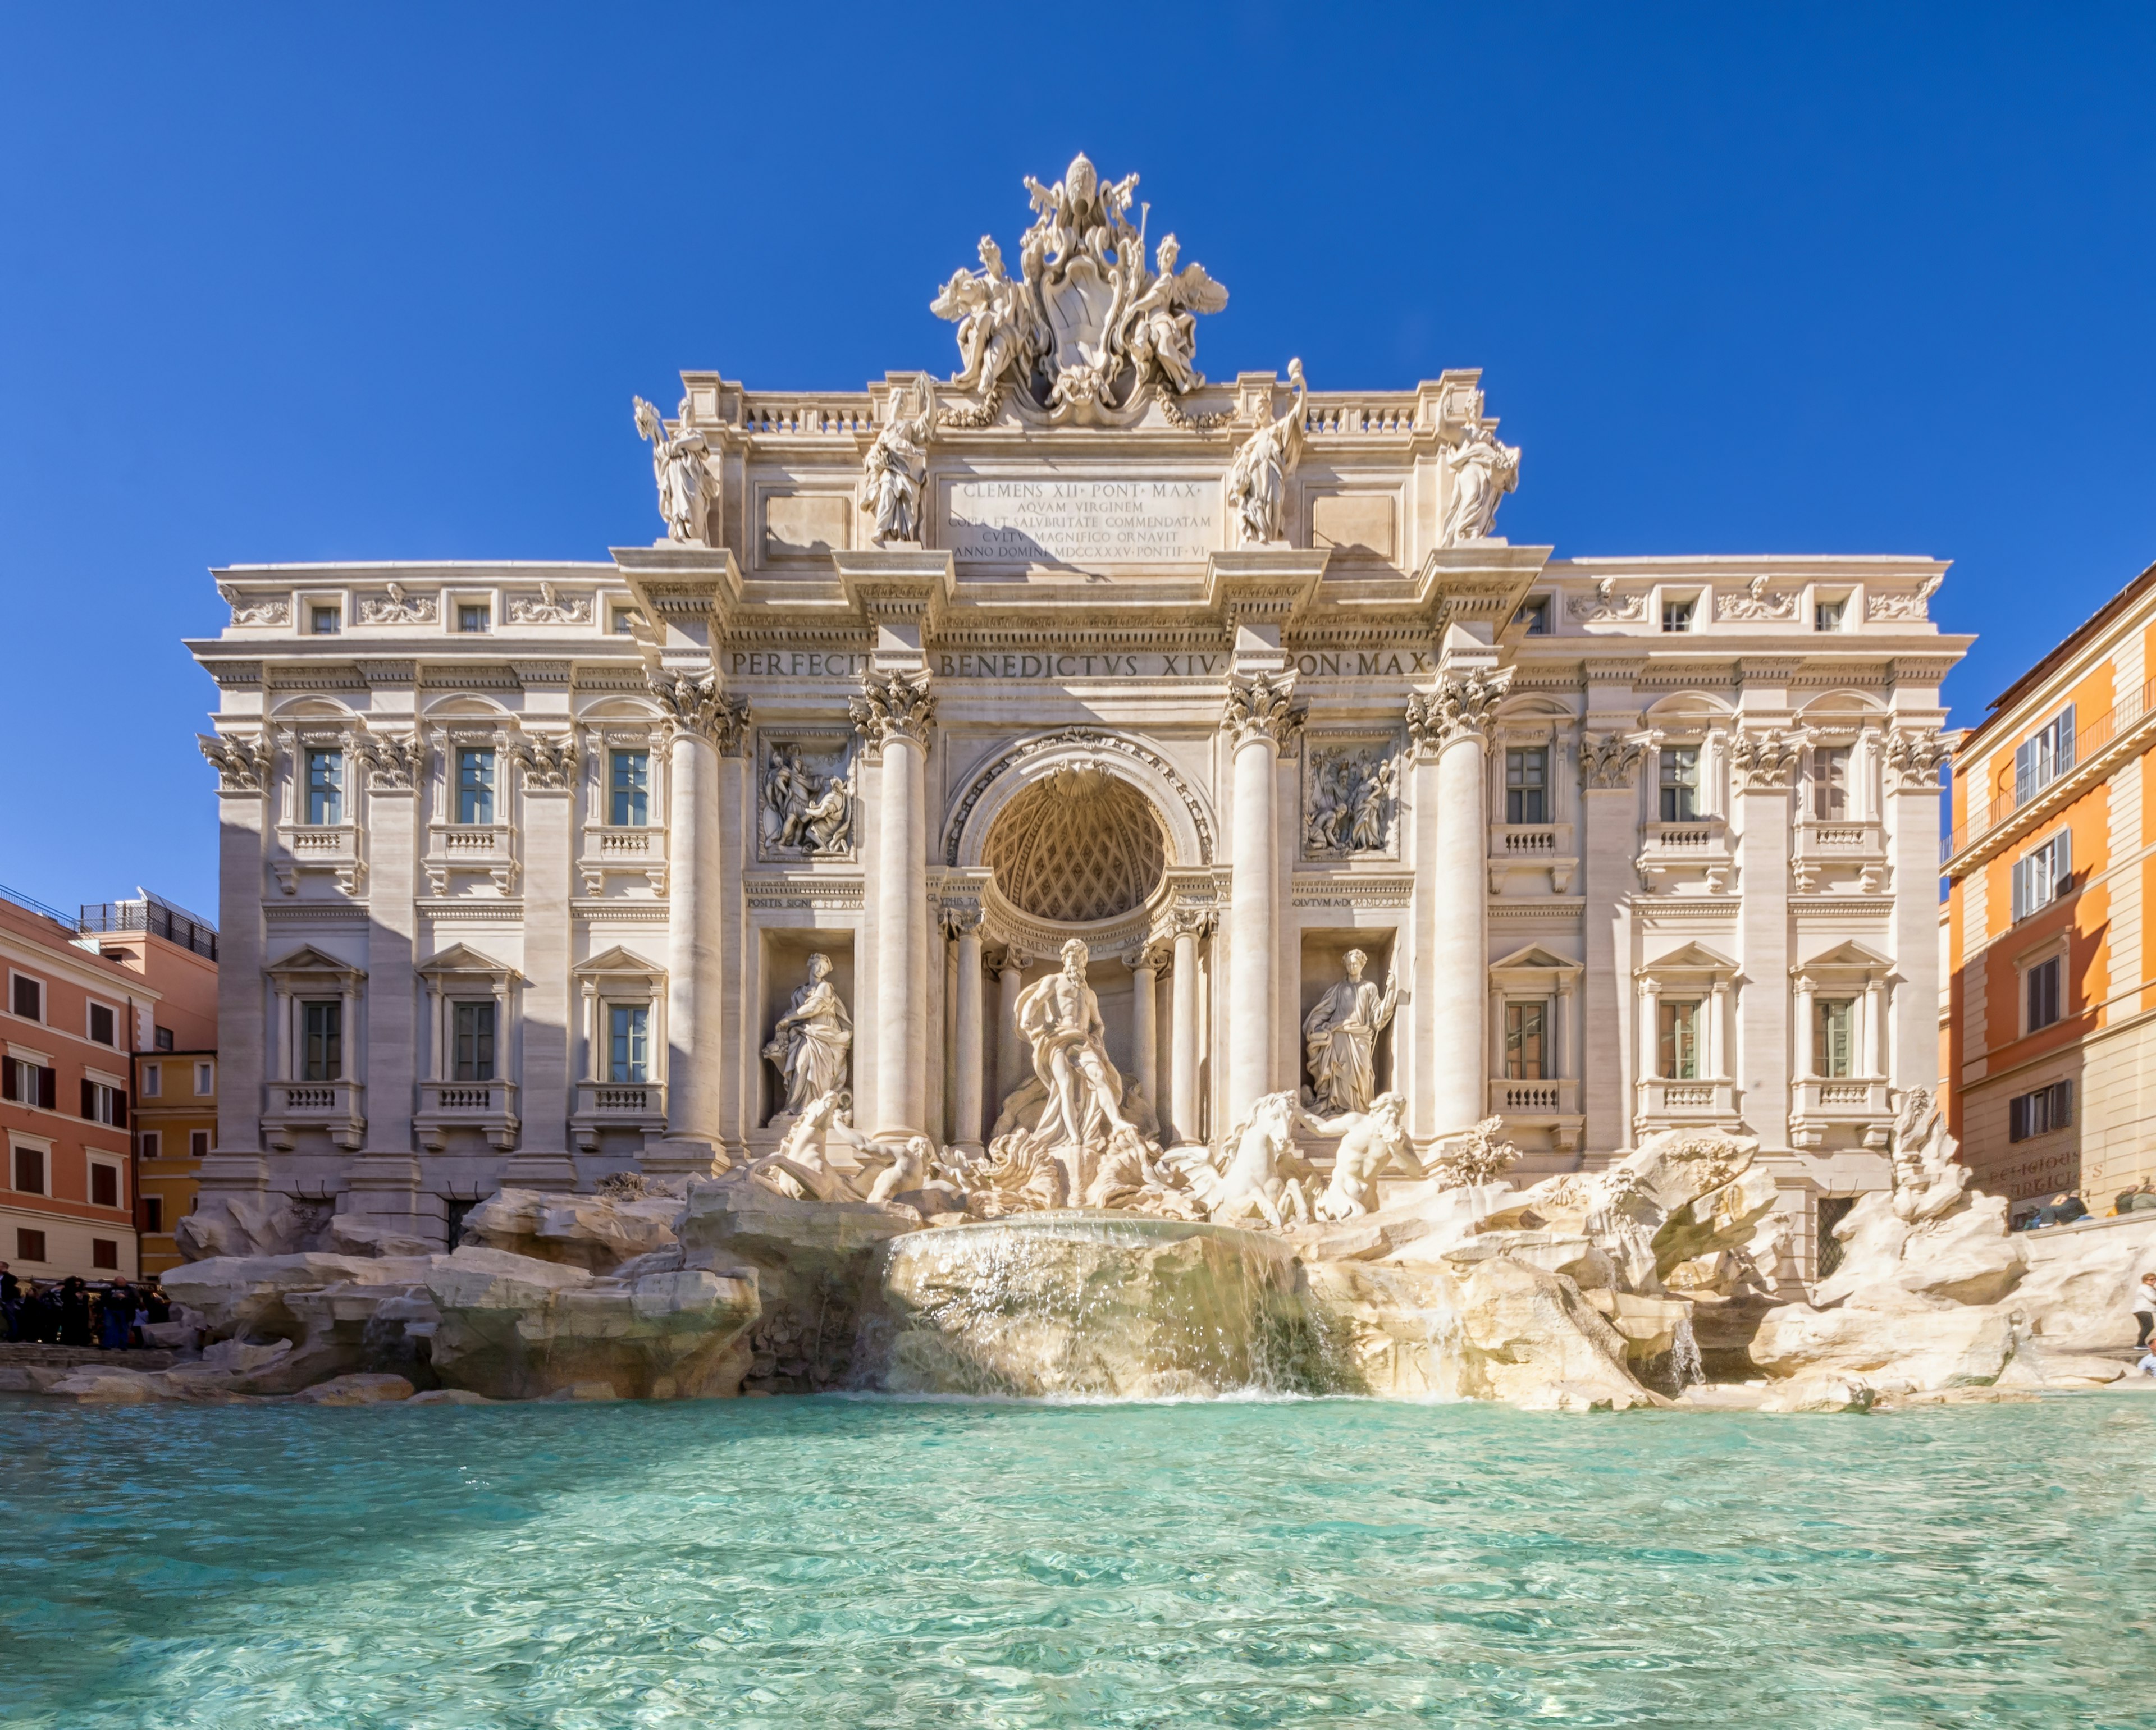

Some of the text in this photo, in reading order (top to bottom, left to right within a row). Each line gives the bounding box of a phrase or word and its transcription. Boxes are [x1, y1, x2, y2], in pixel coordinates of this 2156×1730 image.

[963, 484, 1043, 498] CLEMENS
[1017, 502, 1143, 515] AQVAM VIRGINEM
[948, 516, 1211, 528] COPIA ET SALVBRITATE COMMENDATAM
[983, 532, 1178, 542] CVLTV MAGNIFICO ORNAVIT
[955, 547, 994, 557] ANNO
[999, 547, 1048, 557] DOMINI
[732, 653, 872, 676] PERFECIT
[940, 654, 1138, 678] BENEDICTVS
[748, 899, 782, 908] POSITIS
[787, 899, 817, 908] SIGNIS
